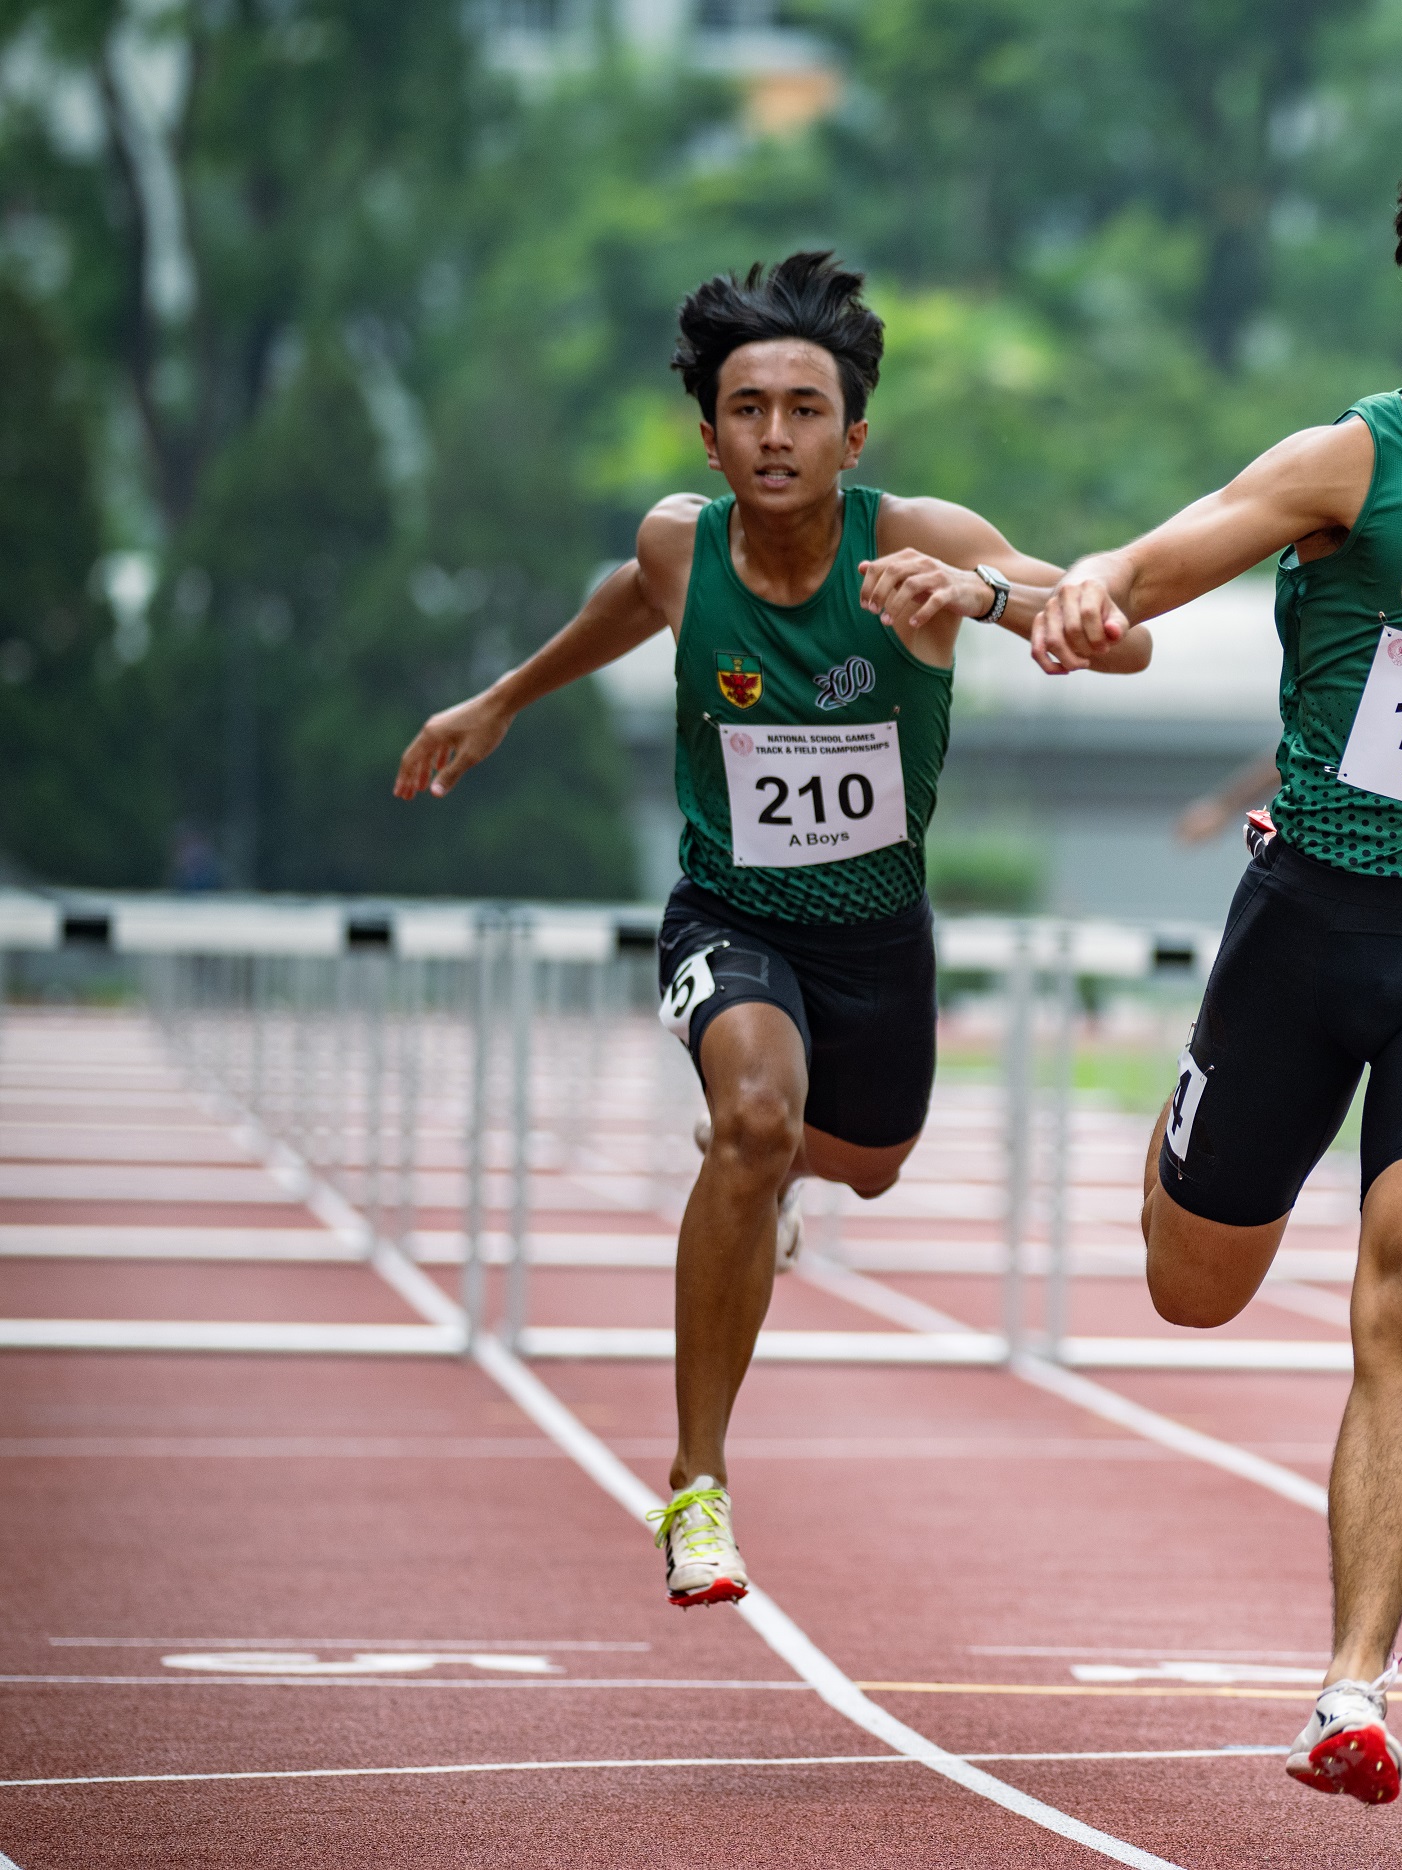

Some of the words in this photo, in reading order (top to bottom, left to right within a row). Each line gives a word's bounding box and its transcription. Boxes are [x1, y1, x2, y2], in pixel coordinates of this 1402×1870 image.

[813, 655, 876, 712] 200
[755, 746, 783, 754] TRACK
[785, 746, 792, 754] &
[794, 746, 817, 754] FIELD
[819, 741, 890, 754] CHAMPIONSHIPS
[767, 734, 808, 743] NATIONAL
[810, 734, 843, 743] SCHOOL
[845, 733, 876, 743] GAMES
[755, 773, 875, 826] 210
[789, 834, 802, 847] A
[806, 831, 850, 846] Boys
[671, 962, 695, 1018] 5
[1172, 1069, 1192, 1136] 4
